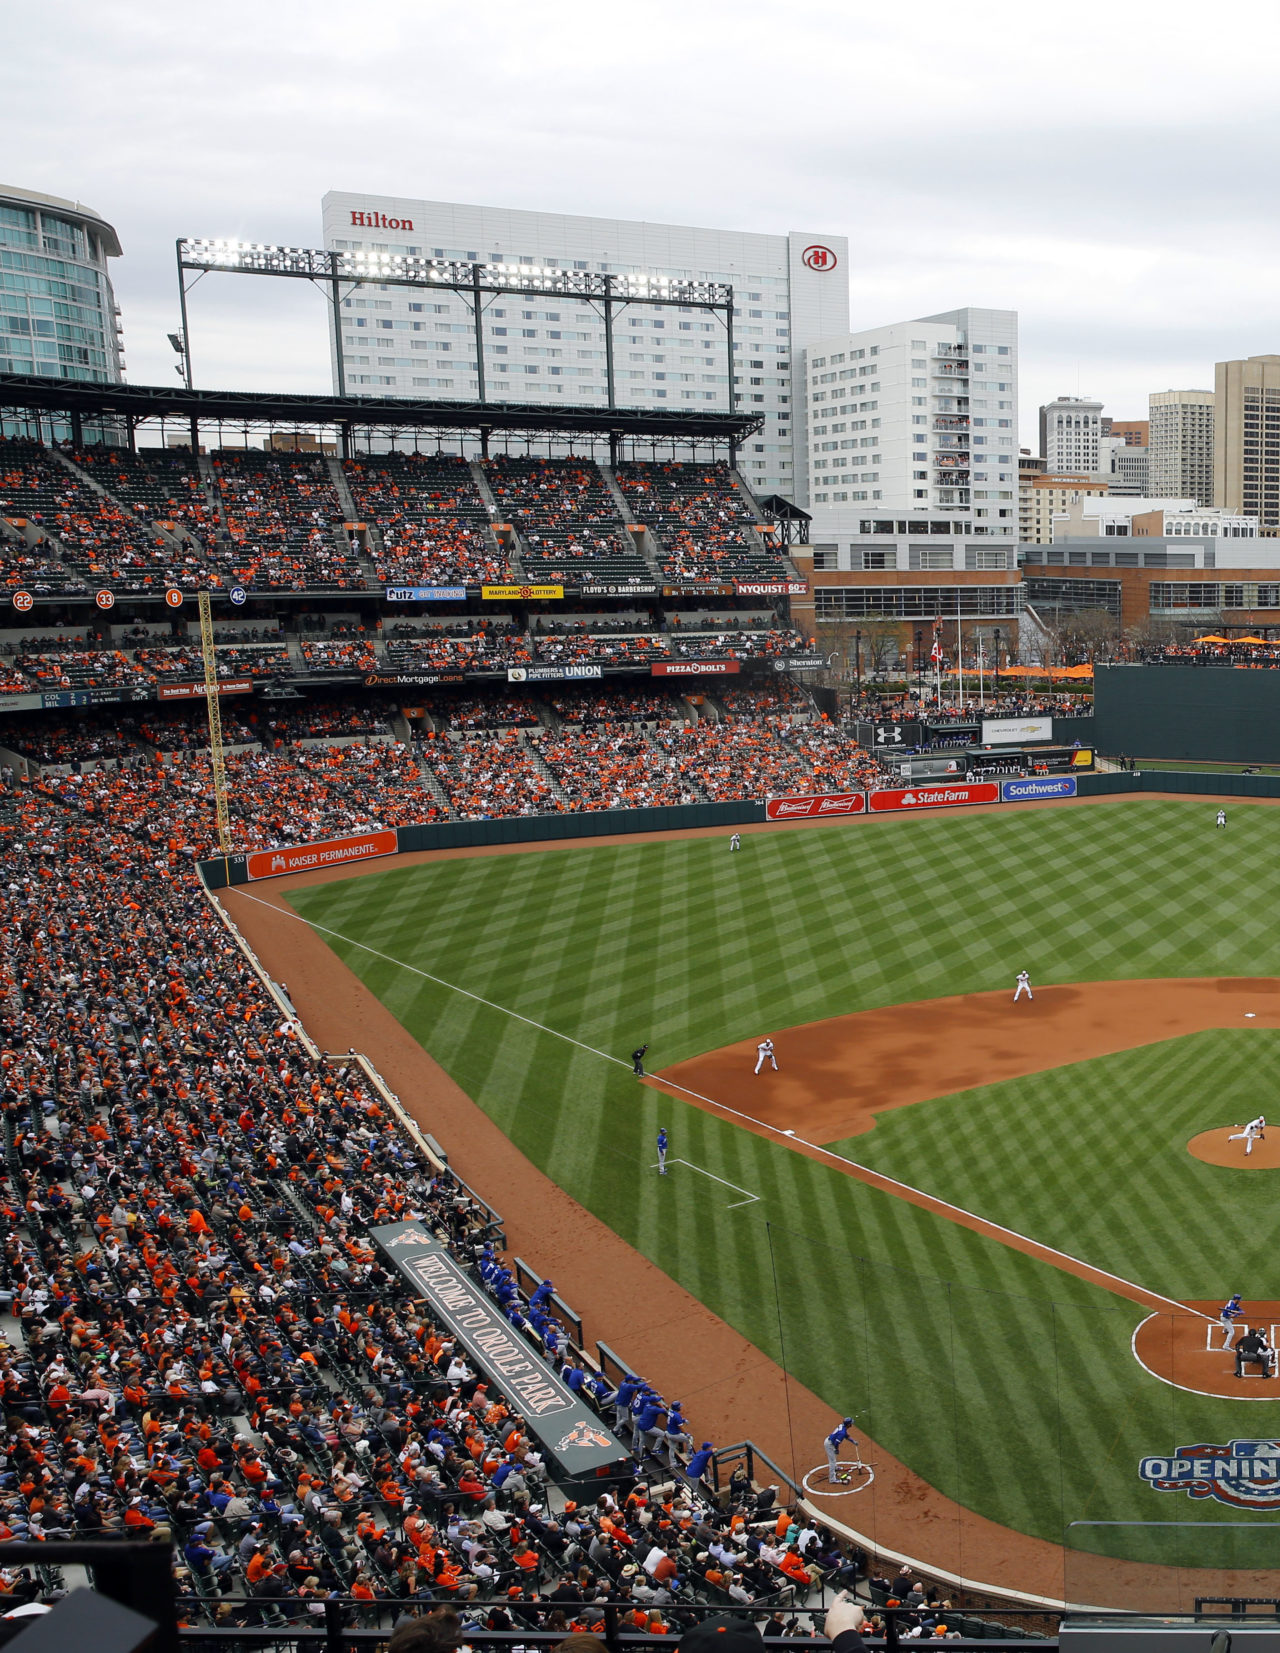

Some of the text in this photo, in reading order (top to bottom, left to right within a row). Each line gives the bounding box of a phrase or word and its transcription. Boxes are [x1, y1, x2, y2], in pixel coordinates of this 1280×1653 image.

[350, 211, 414, 231] Hilton
[583, 586, 608, 594] FLOYD'S
[739, 585, 783, 594] NYQUIST
[16, 595, 31, 607] 22
[99, 594, 112, 605] 33
[171, 593, 178, 603] 8
[232, 590, 244, 601] 42
[565, 665, 601, 676] UNION
[666, 665, 692, 673] PIZZA
[364, 674, 463, 686] DirectMortgageLoans
[1009, 782, 1063, 796] Southwest
[233, 856, 245, 864] 333
[288, 843, 378, 868] KAISER PERMANENTE
[411, 1254, 566, 1414] WELCOME TO ORIOLE PARK
